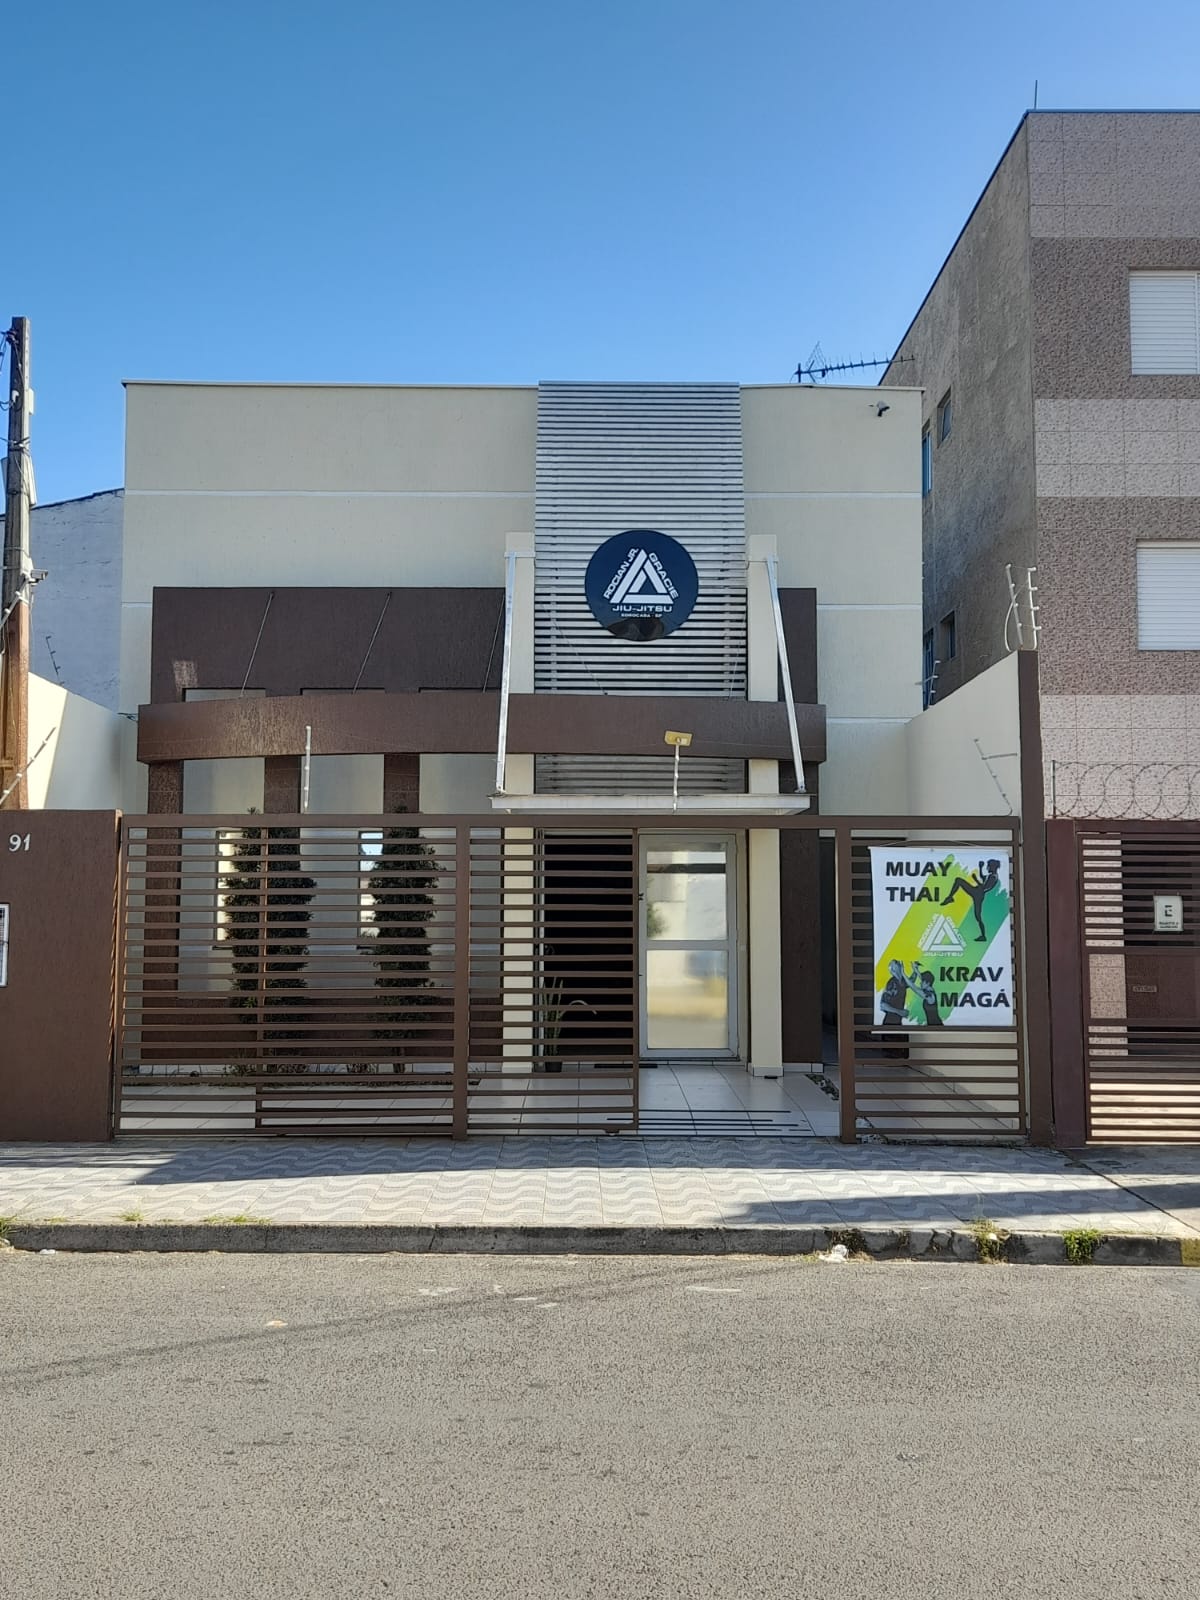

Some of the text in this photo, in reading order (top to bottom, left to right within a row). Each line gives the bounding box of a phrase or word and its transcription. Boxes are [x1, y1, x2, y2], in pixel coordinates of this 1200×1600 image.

[603, 561, 629, 599] ROCIAN
[649, 552, 679, 599] GRACIE
[8, 833, 31, 852] 91
[885, 861, 952, 877] MUAY
[885, 886, 940, 902] THAI
[939, 966, 1004, 982] KRAV
[940, 988, 1010, 1008] MAGÁ
